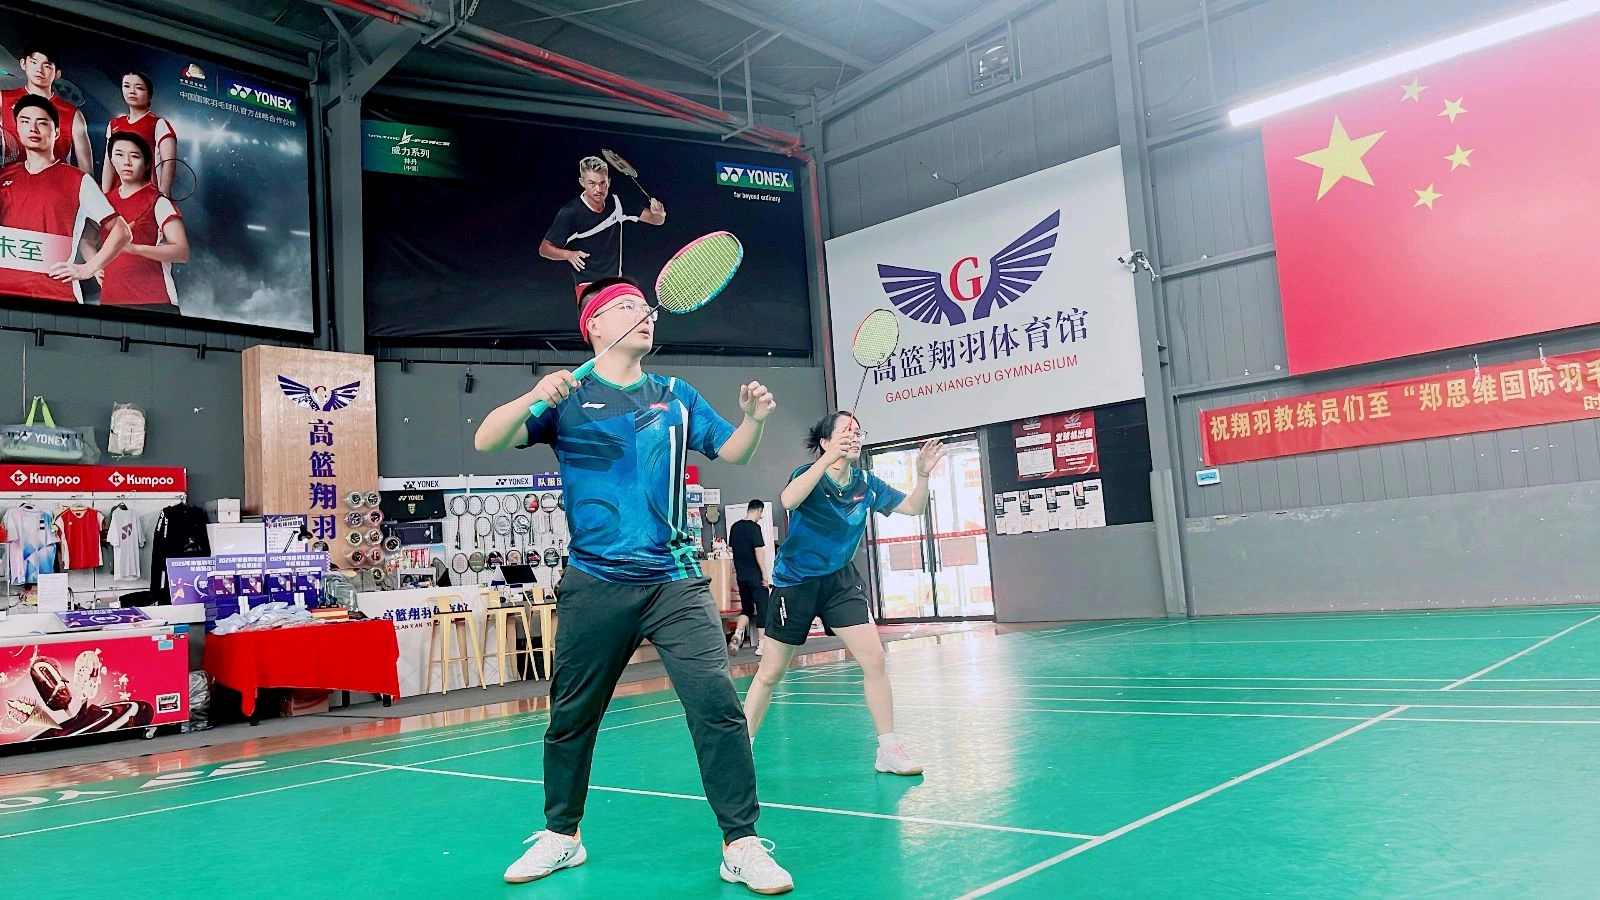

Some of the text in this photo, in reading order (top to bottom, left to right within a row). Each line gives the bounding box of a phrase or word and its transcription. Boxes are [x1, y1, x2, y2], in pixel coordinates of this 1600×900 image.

[254, 90, 292, 110] YONEX
[391, 146, 430, 158] 威力系列
[746, 169, 788, 187] YONEX
[742, 192, 760, 201] beyond
[760, 195, 781, 204] ordinary
[949, 256, 983, 301] G
[871, 307, 1089, 386] 高篮翔羽体育馆
[885, 354, 1079, 403] GAOLAN XIANGYU GYMNASIUM
[35, 432, 68, 448] YONEX
[29, 472, 81, 487] Kumpoo
[126, 474, 174, 488] Kumpoo
[308, 418, 337, 541] 高篮翔羽
[417, 480, 440, 488] YONEX
[508, 477, 529, 486] YONEX
